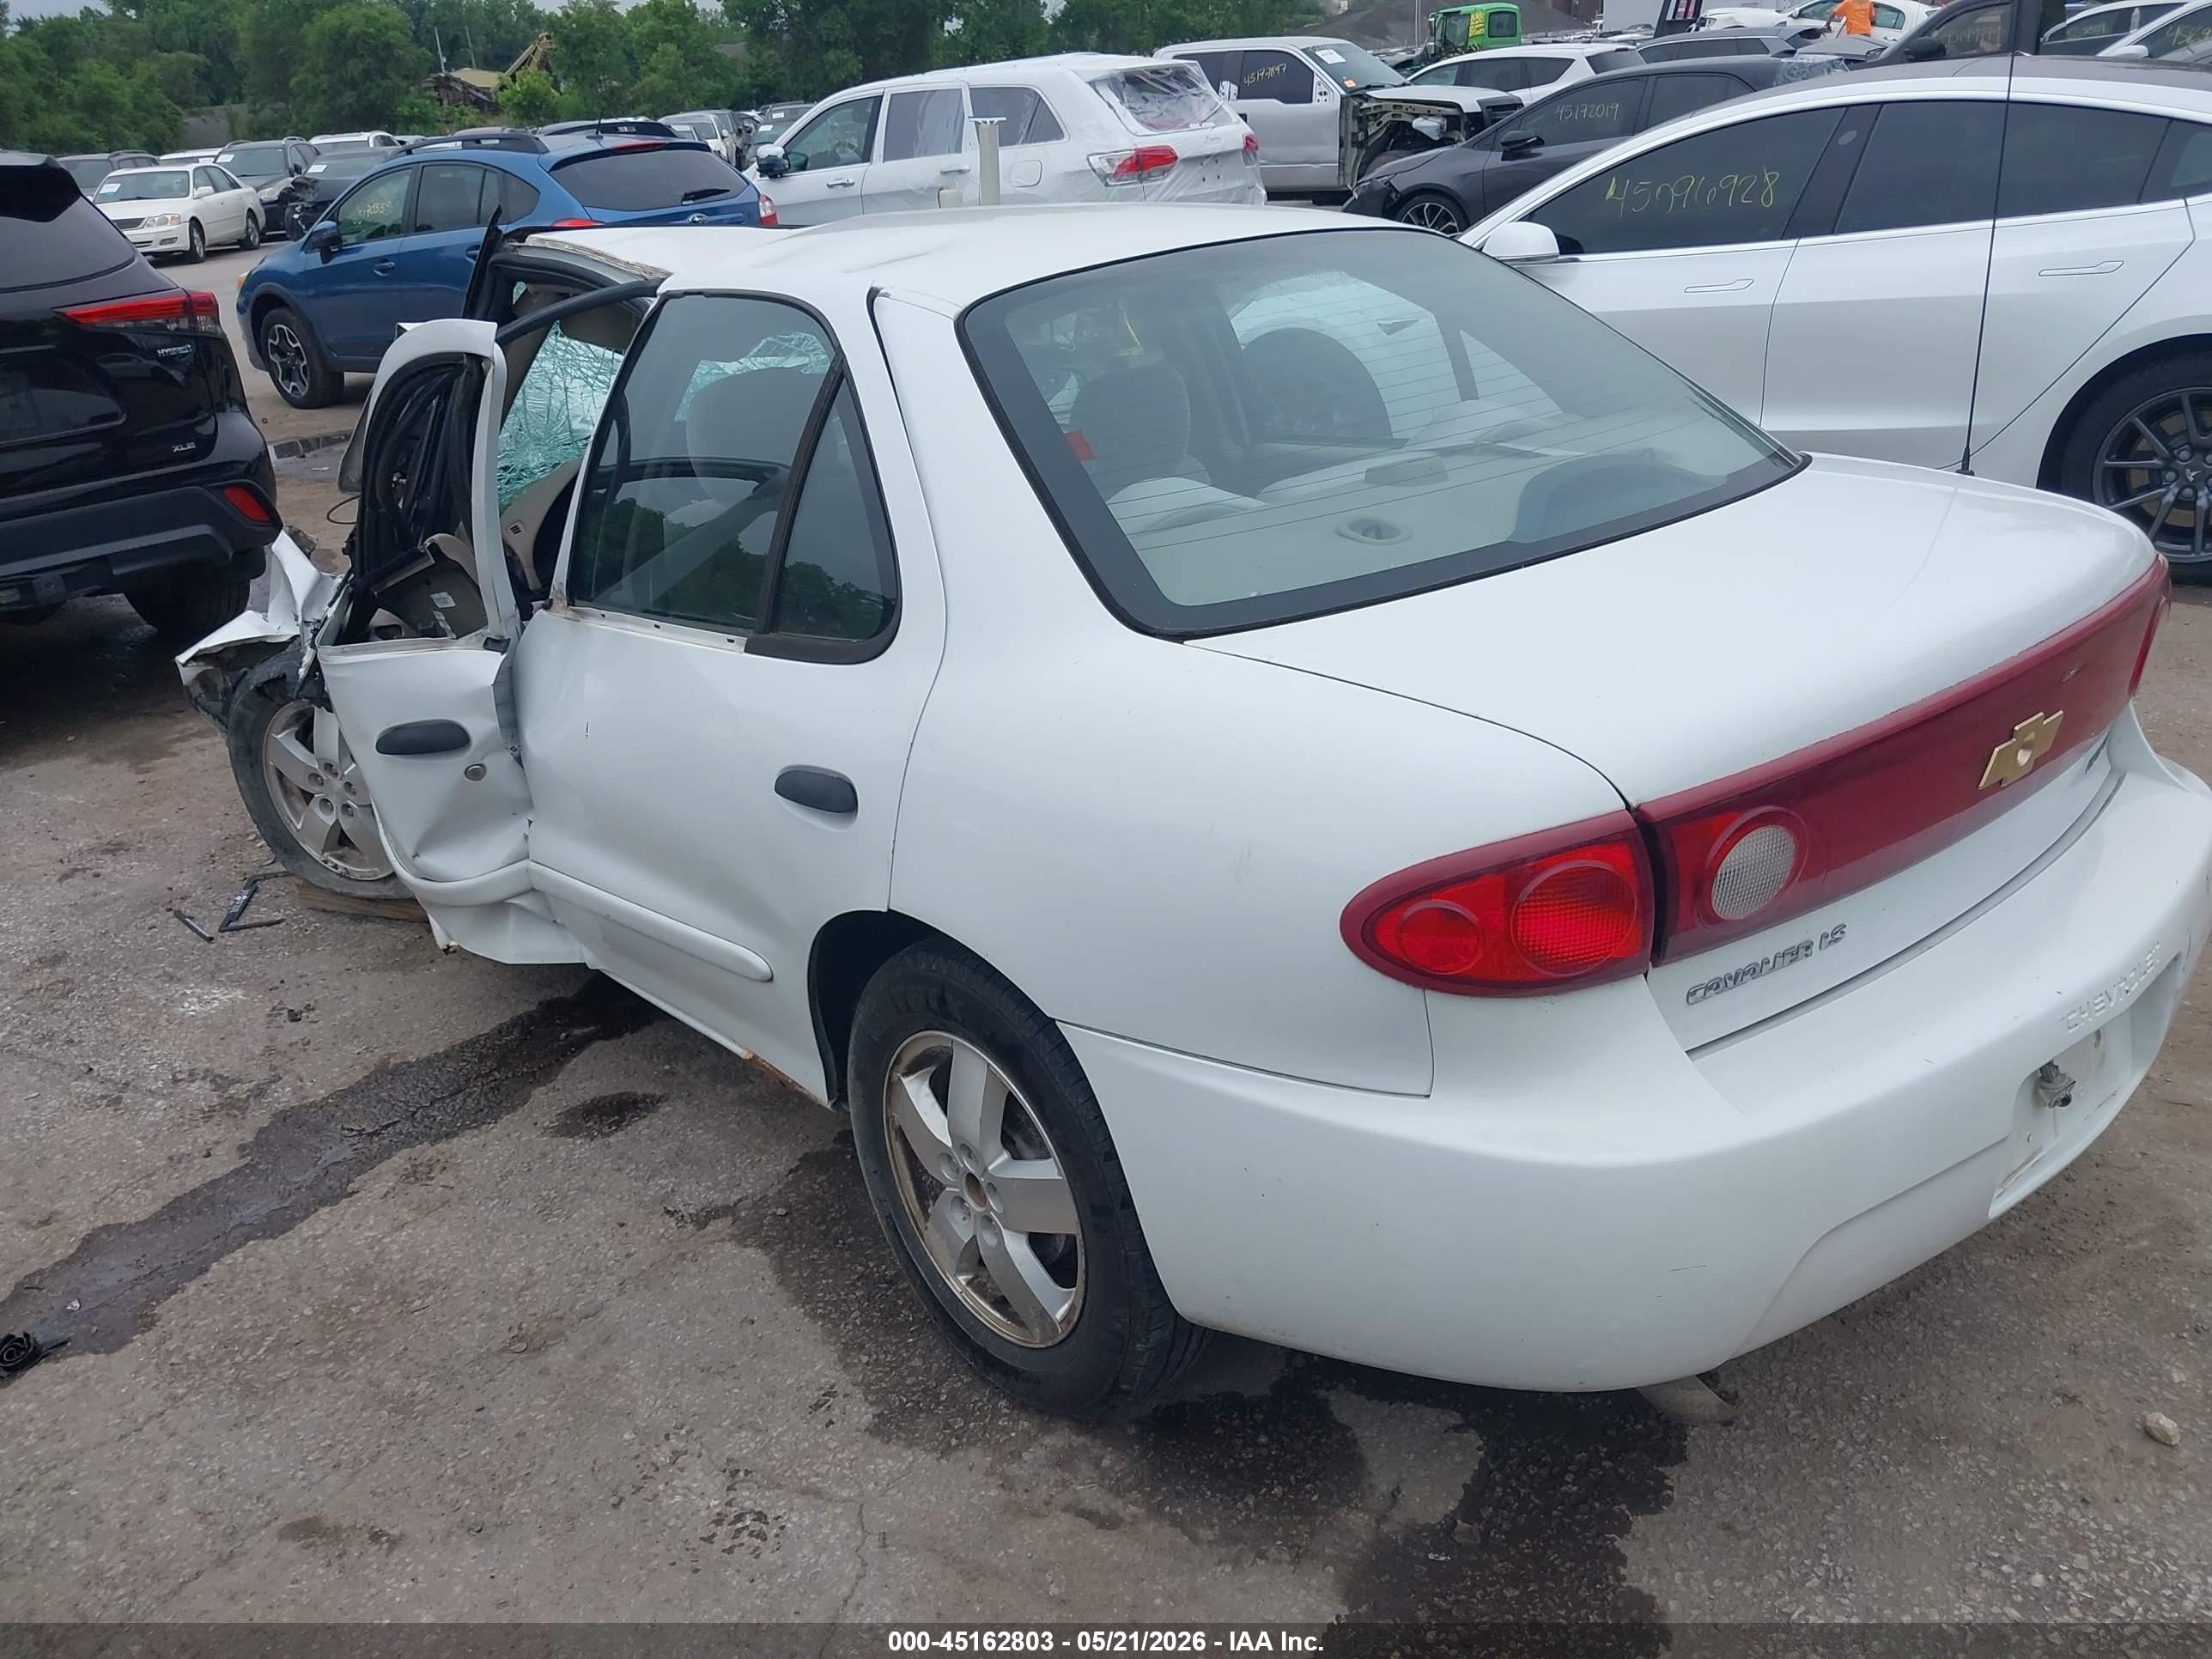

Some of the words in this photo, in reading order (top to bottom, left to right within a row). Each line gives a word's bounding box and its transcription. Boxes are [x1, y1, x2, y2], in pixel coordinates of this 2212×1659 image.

[1554, 103, 1619, 121] 45172019
[172, 441, 197, 453] XLE
[1686, 939, 1814, 1006] CAVALIER
[1819, 923, 1847, 951] LS
[2066, 940, 2161, 1034] CHEVROLET
